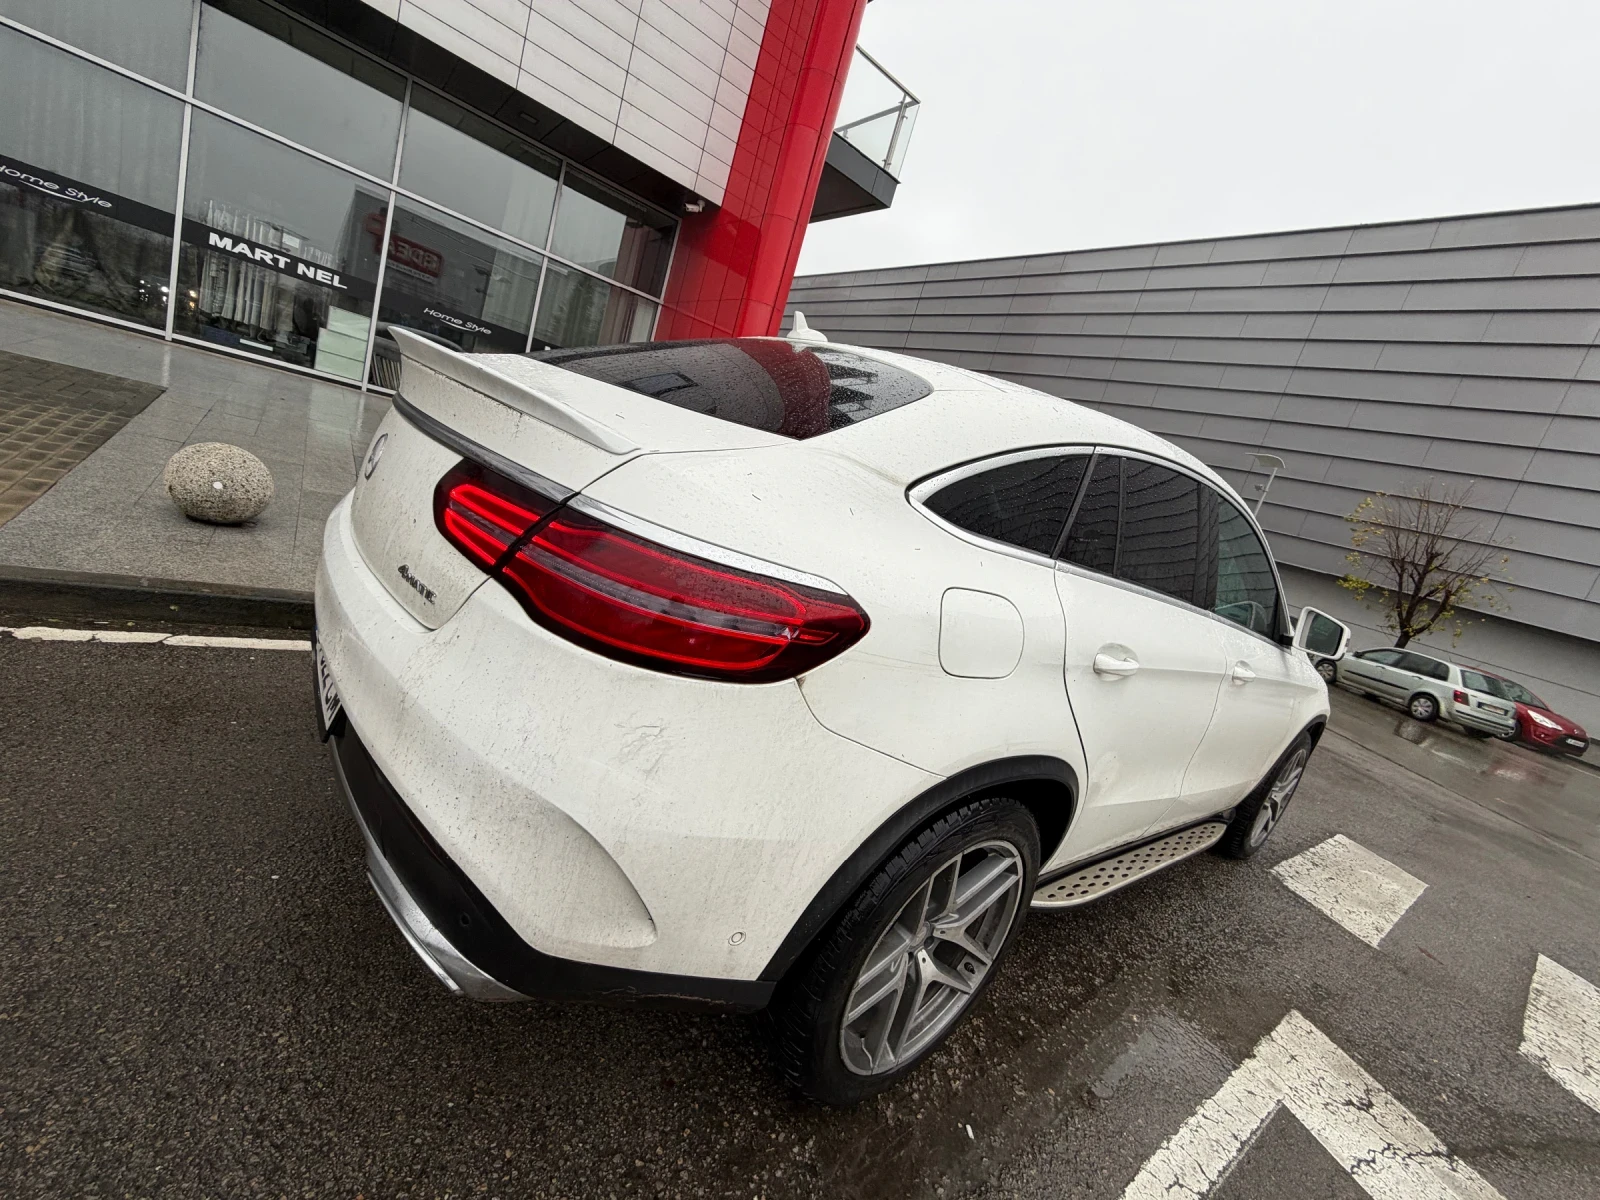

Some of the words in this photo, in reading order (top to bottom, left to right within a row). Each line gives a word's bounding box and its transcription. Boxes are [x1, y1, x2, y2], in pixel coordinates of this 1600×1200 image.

[65, 187, 113, 208] Style
[208, 232, 291, 269] MART
[297, 262, 348, 290] NEL
[423, 307, 463, 325] Home
[465, 321, 492, 335] Style
